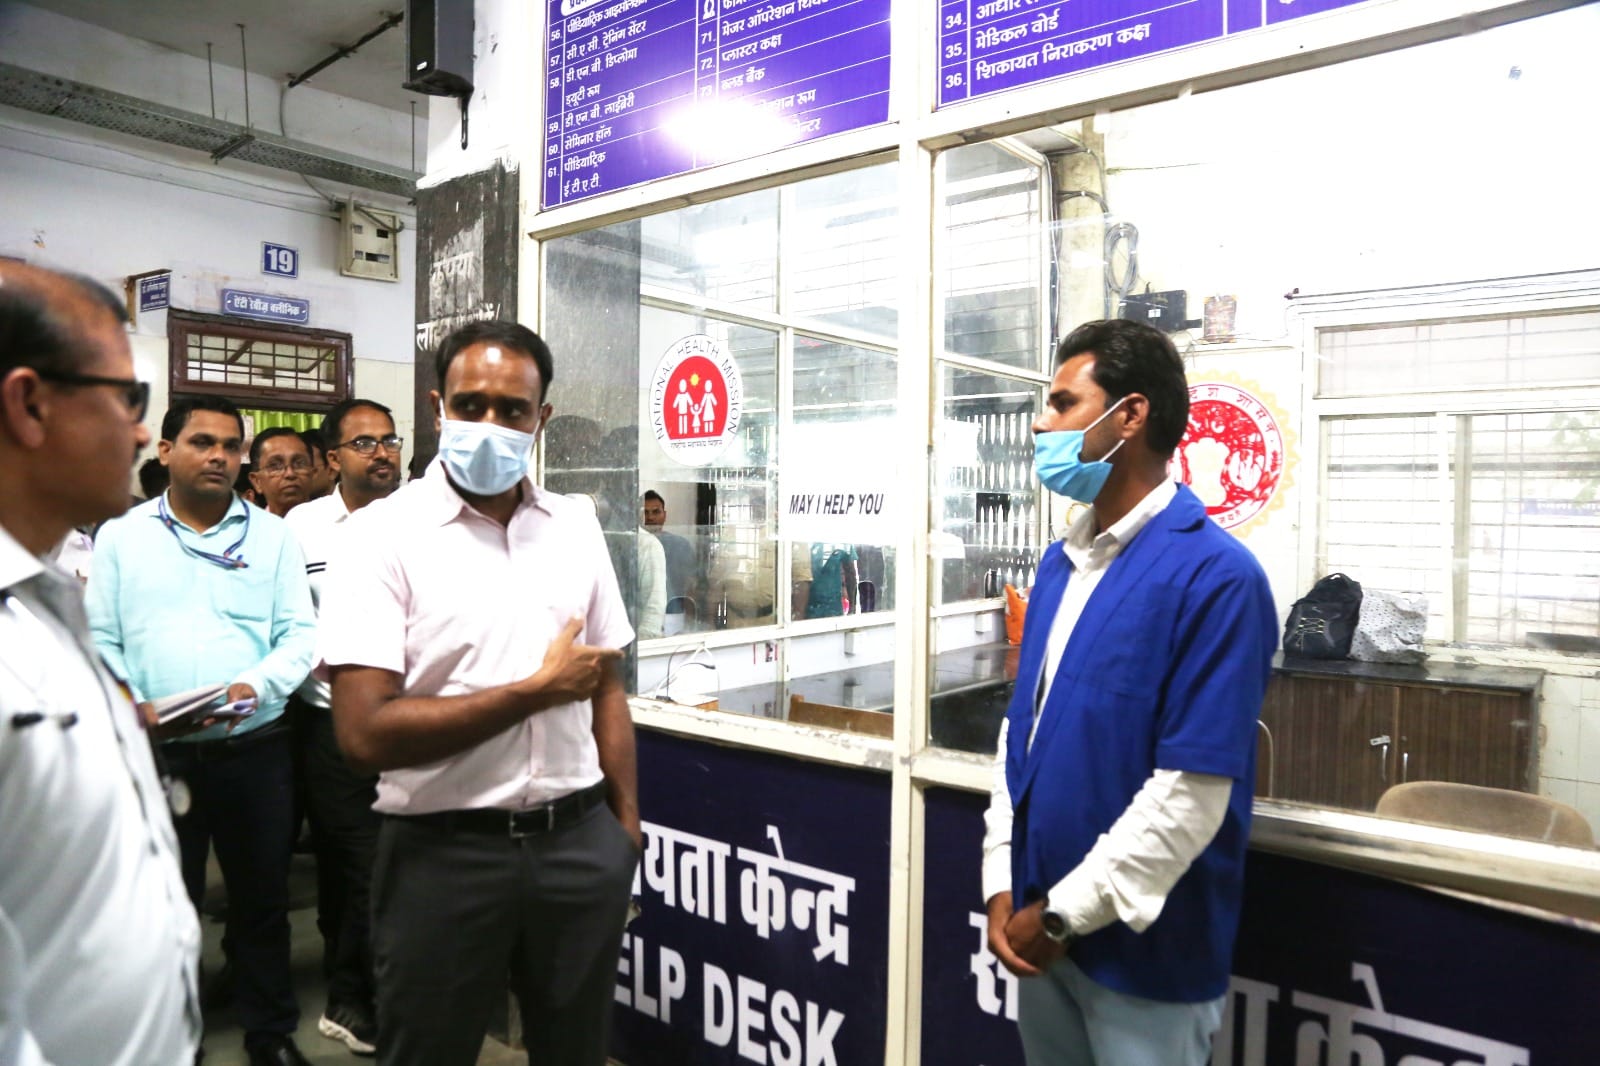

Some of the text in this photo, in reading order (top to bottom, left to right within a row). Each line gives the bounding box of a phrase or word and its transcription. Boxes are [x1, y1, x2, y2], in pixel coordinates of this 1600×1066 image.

[722, 21, 745, 36] मेजर
[747, 2, 795, 28] ऑपरेशन
[721, 44, 758, 62] प्लास्टर
[760, 34, 783, 50] कक्ष
[976, 27, 1028, 48] मेडिकल
[976, 51, 1039, 80] शिकायत
[1042, 33, 1113, 63] निराकरण
[1116, 23, 1152, 44] कक्ष
[267, 248, 294, 273] 19
[653, 340, 740, 440] NATIONAL HEALTH MISSION
[789, 493, 884, 515] MAY I HELP YOU
[631, 820, 856, 966] यता केन्द्र
[614, 931, 846, 1066] ELP DESK
